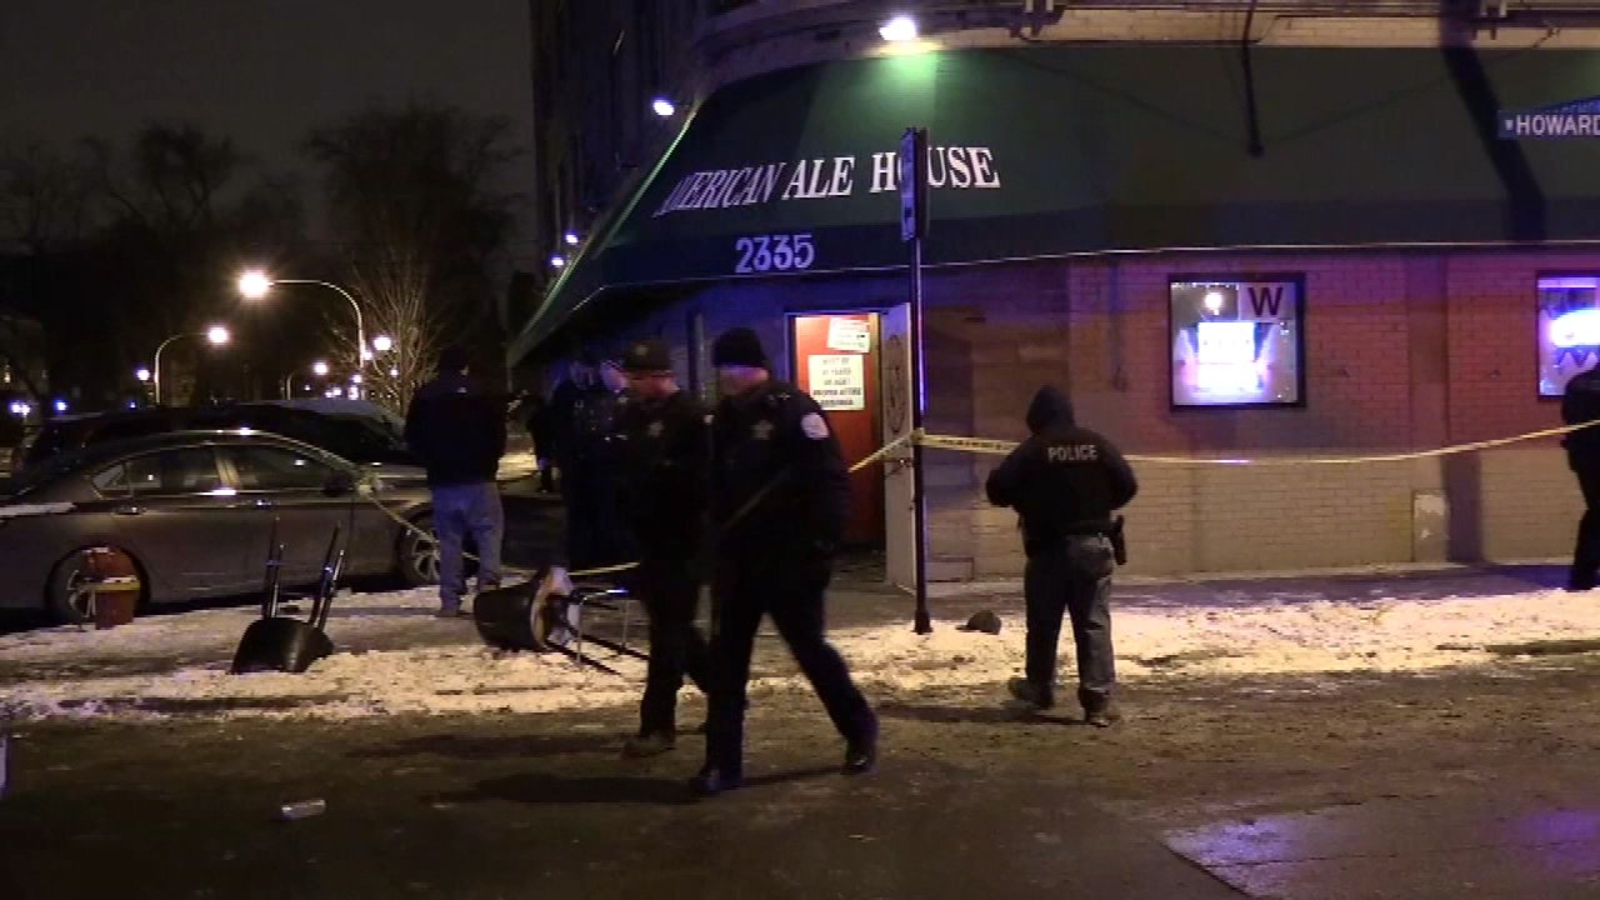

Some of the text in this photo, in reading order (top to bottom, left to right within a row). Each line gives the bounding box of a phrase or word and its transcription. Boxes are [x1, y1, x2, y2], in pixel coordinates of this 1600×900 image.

[782, 157, 855, 199] ALE
[869, 147, 1001, 193] HUSE
[735, 234, 815, 275] 2335
[1248, 287, 1284, 317] W
[1047, 444, 1098, 462] POLICE
